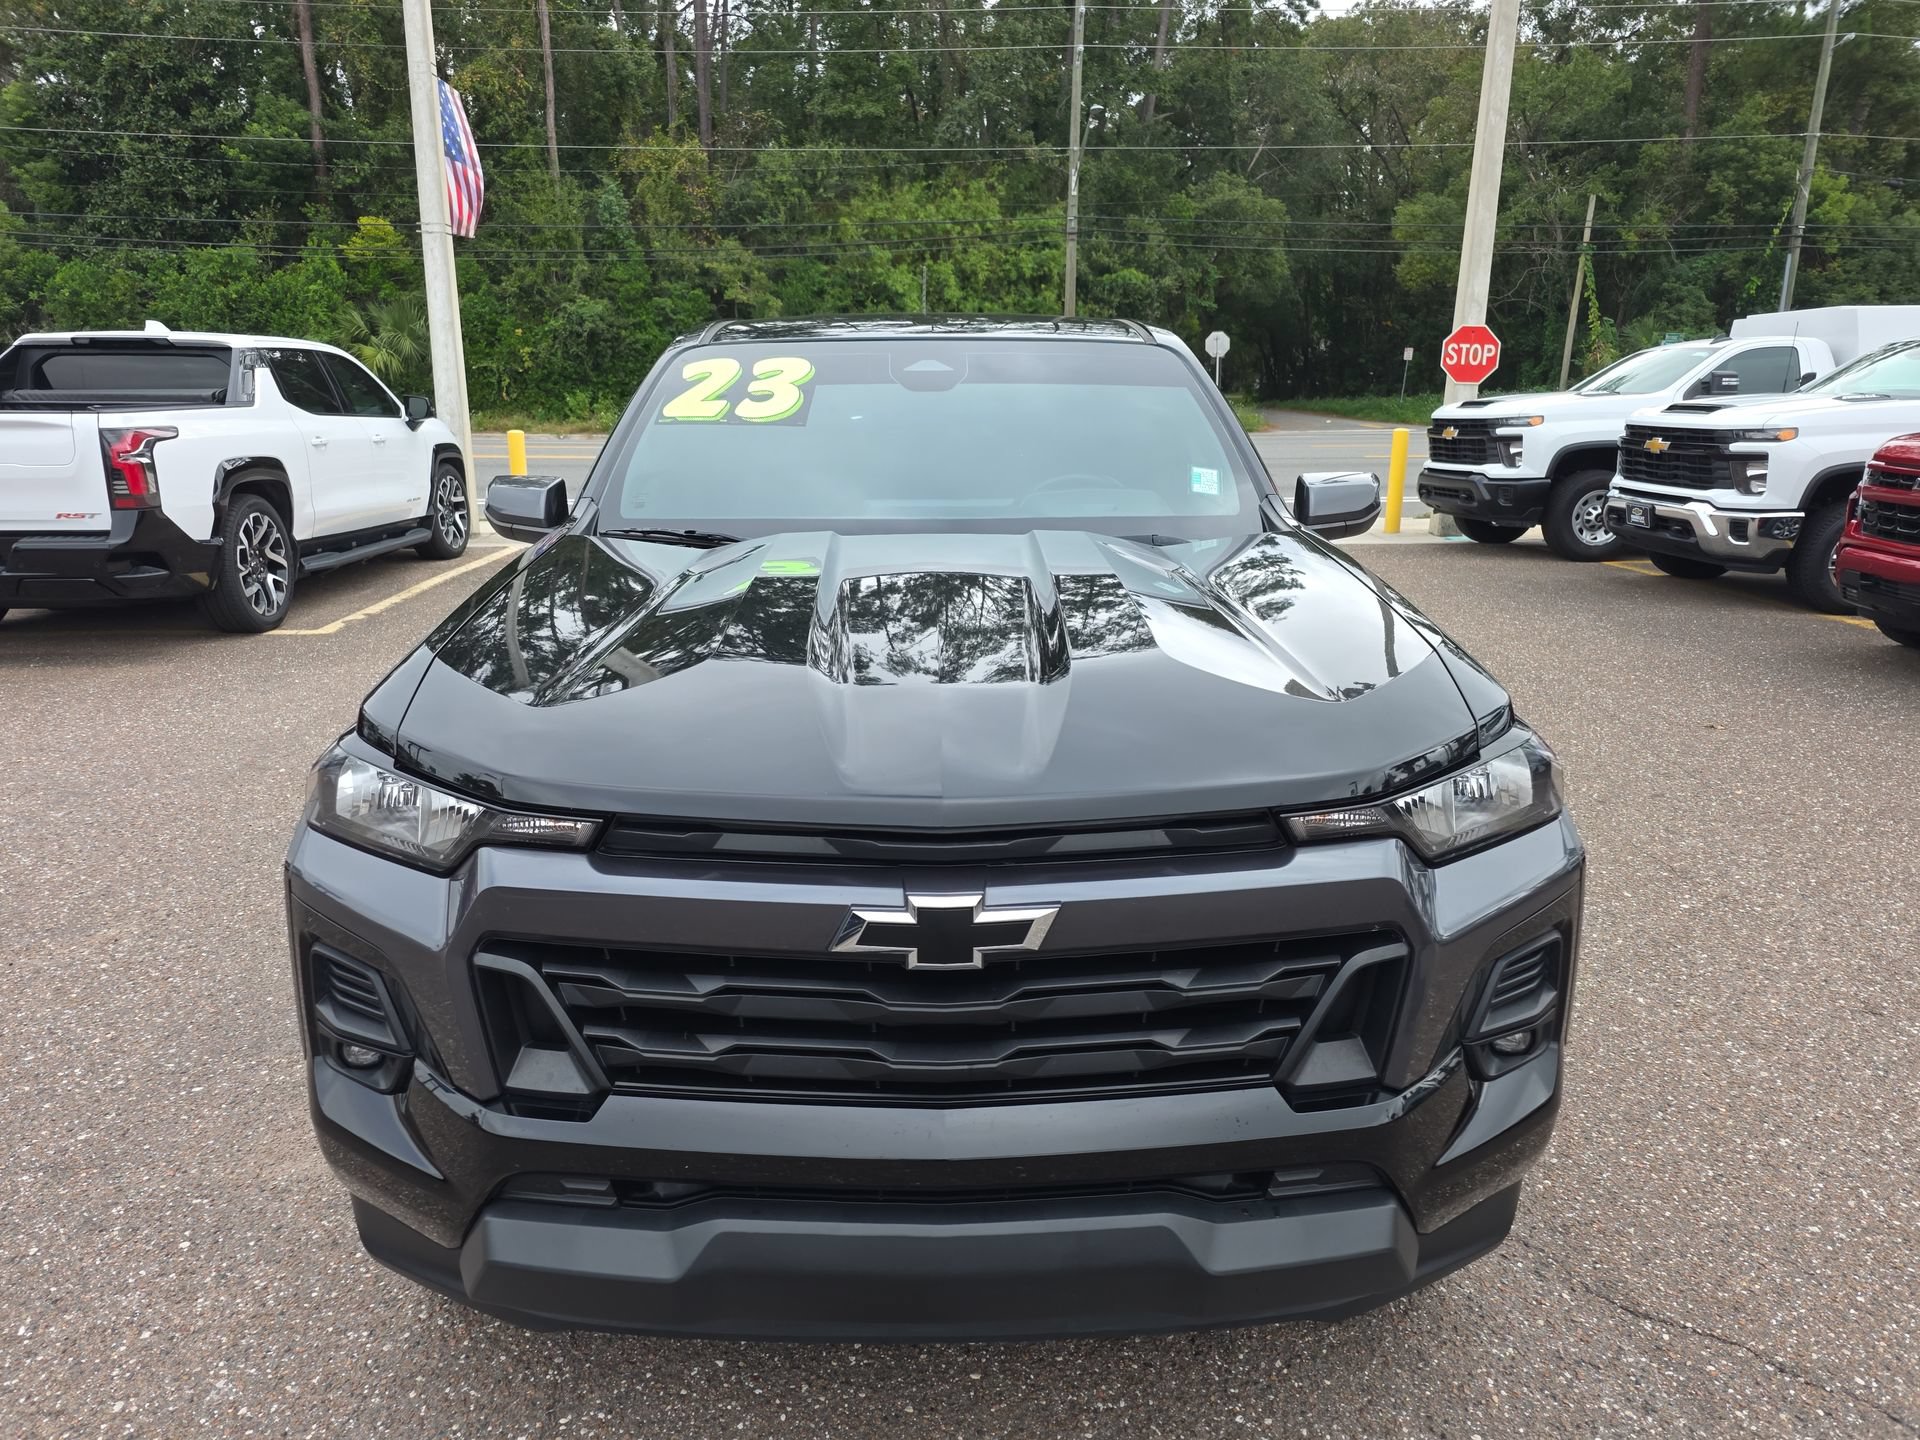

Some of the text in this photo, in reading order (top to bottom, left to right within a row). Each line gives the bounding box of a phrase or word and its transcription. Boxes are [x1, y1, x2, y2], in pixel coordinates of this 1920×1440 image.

[1445, 343, 1496, 366] STOP
[662, 357, 816, 422] 23
[55, 512, 102, 520] RST
